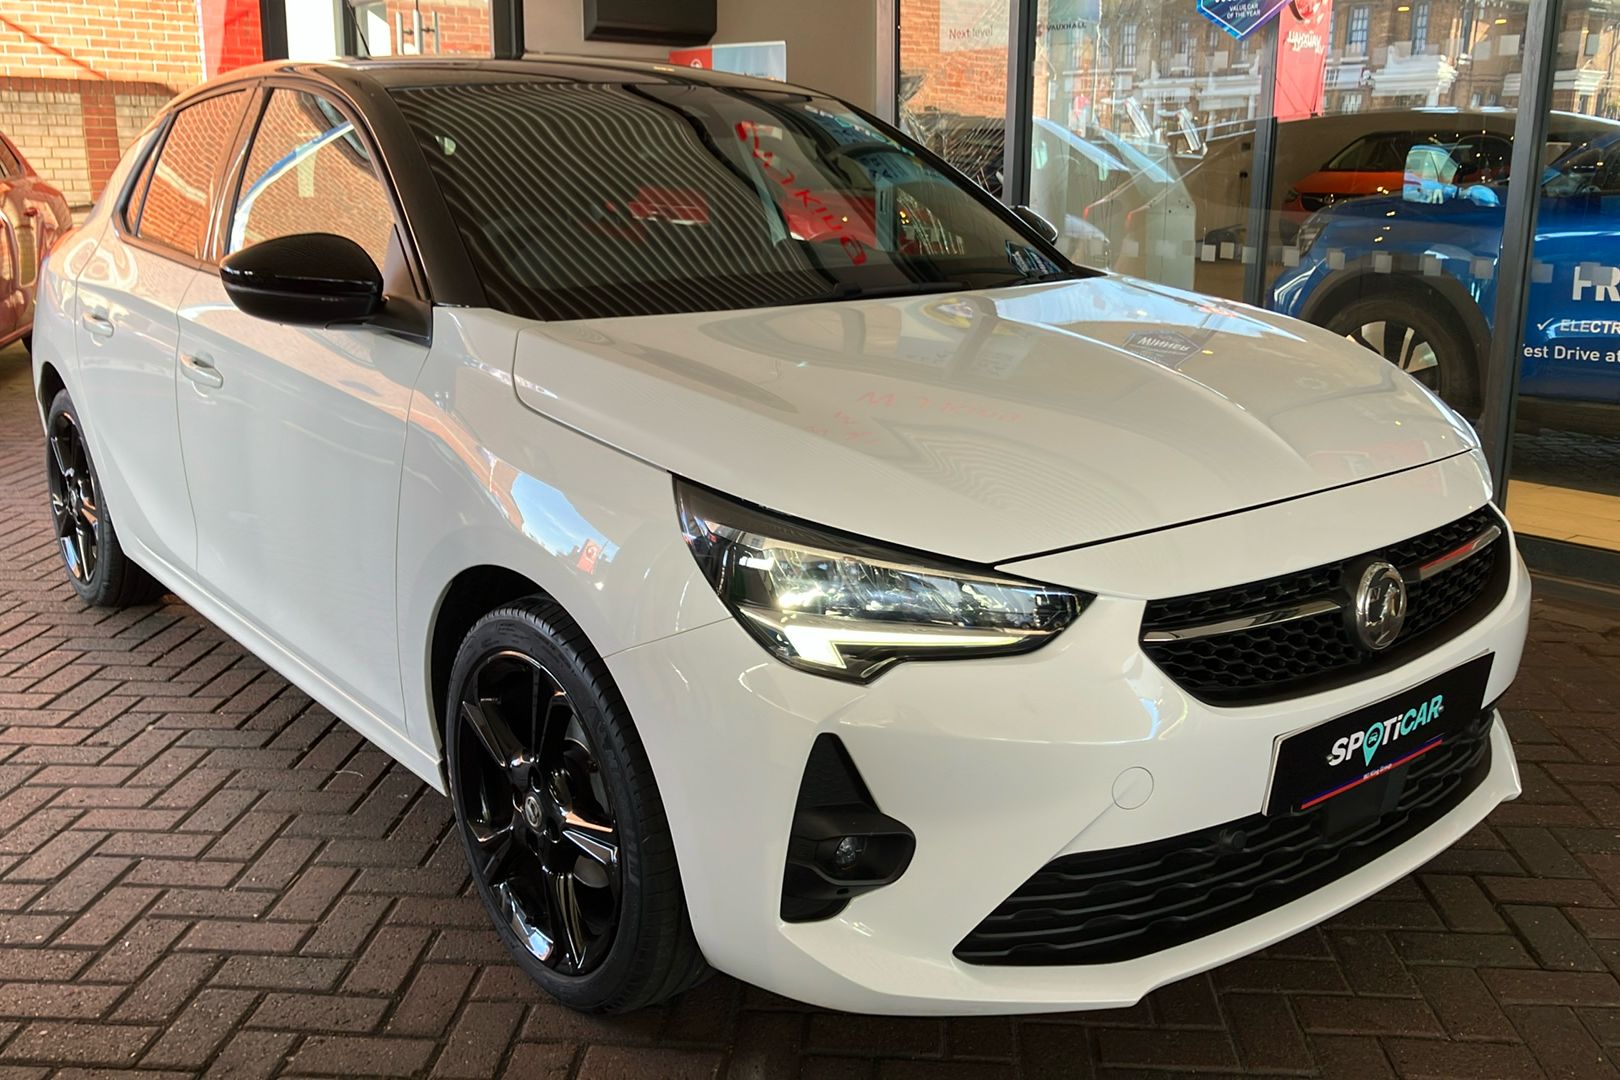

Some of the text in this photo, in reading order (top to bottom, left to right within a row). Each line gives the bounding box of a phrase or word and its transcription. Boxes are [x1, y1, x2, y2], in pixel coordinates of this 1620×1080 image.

[1246, 9, 1261, 17] YEAR
[949, 24, 993, 40] Next level
[1047, 20, 1087, 31] VAUXHALL
[1522, 343, 1549, 359] est
[1553, 345, 1600, 361] Drive
